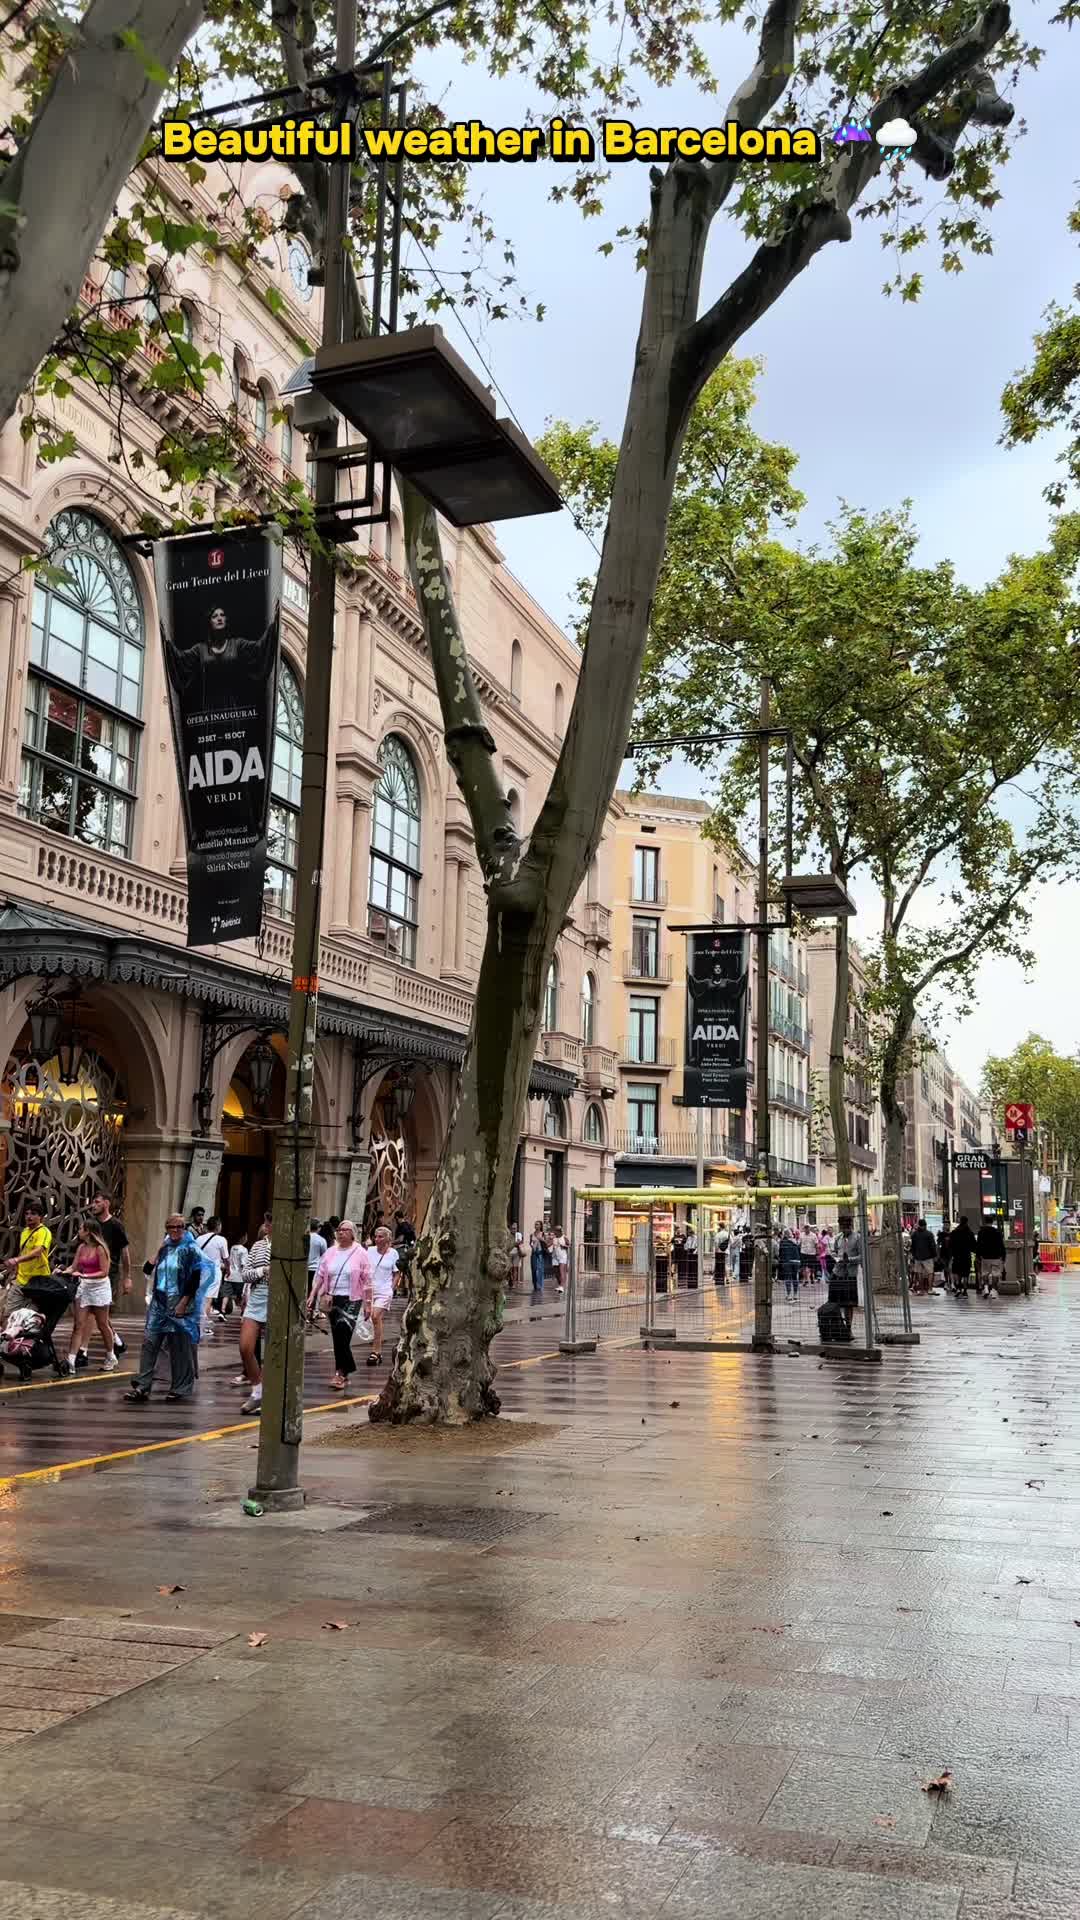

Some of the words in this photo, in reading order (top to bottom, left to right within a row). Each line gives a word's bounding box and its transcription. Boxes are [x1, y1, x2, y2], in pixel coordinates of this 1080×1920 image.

[190, 576, 222, 588] Teatre
[224, 570, 240, 582] del
[242, 568, 271, 580] Liceu
[210, 709, 258, 721] INAUGURAL
[231, 731, 246, 740] OCT
[188, 746, 265, 790] AIDA
[207, 791, 243, 804] VERDI
[692, 1024, 740, 1041] AIDA
[957, 1154, 985, 1162] GRAN
[955, 1161, 987, 1169] METRO
